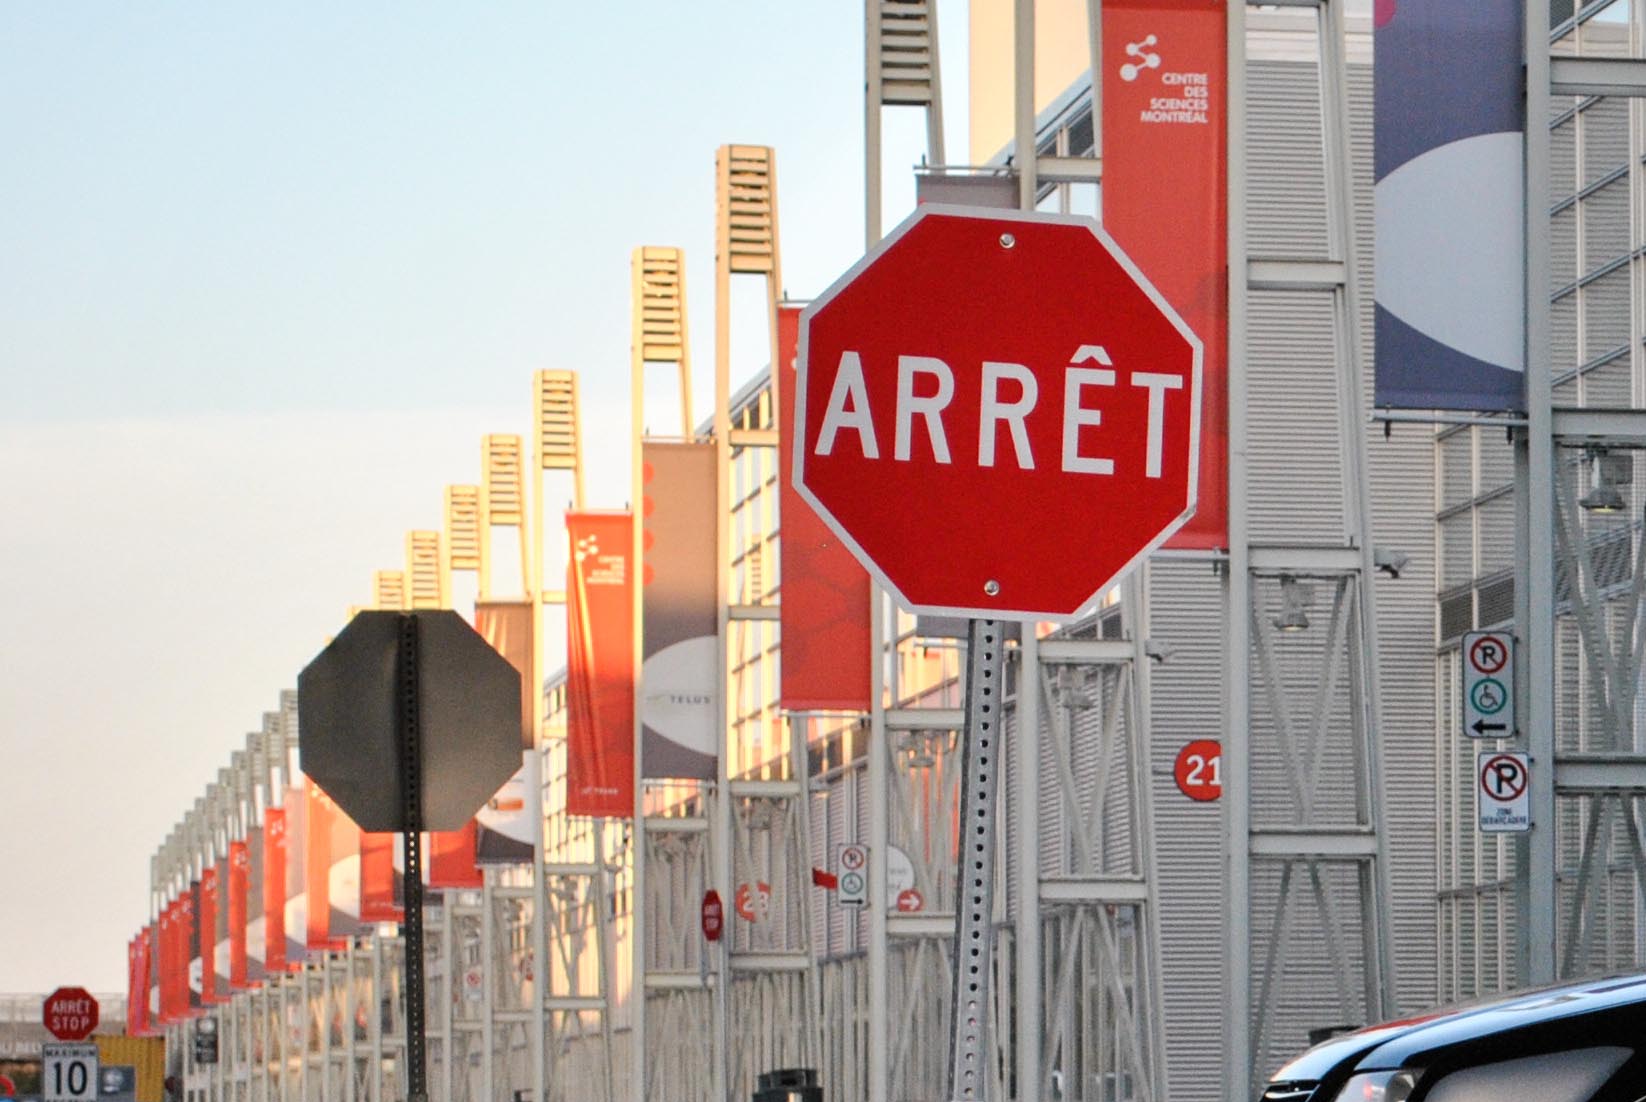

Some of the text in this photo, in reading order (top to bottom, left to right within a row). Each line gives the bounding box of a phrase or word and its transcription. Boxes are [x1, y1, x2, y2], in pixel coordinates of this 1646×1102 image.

[1161, 72, 1208, 85] CENTRE
[1184, 86, 1208, 98] DES
[1149, 97, 1208, 110] SCIENCES
[814, 344, 1183, 479] ARRÊT
[1186, 754, 1221, 786] 21
[53, 1016, 90, 1030] STOP
[54, 1061, 88, 1096] 10
